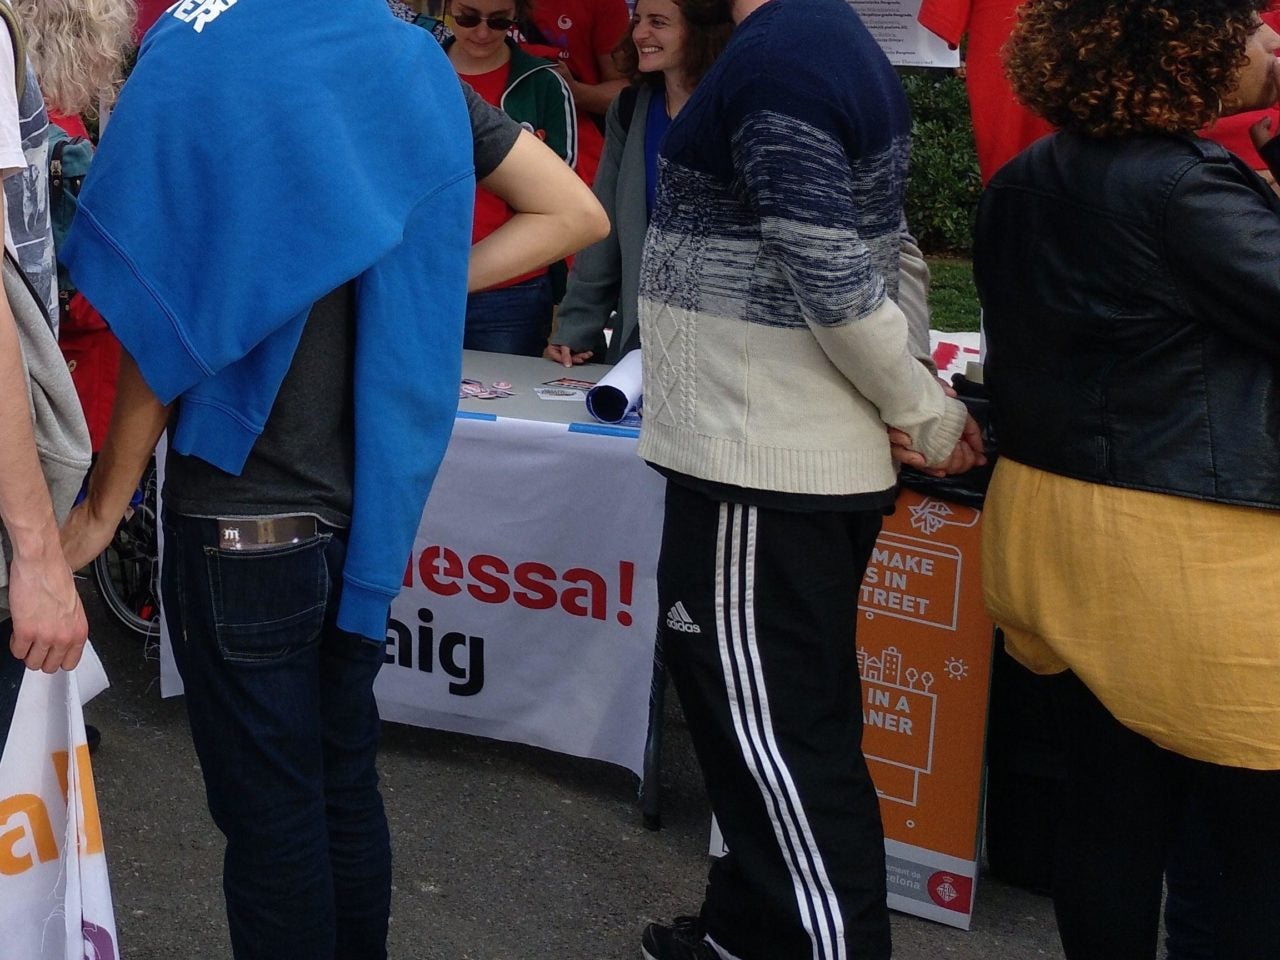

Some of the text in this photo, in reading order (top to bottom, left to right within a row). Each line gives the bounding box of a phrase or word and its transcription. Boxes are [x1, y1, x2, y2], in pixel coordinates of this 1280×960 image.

[871, 547, 934, 577] MAKE
[402, 544, 634, 627] essa!
[884, 570, 907, 591] IN
[666, 618, 701, 633] adidas
[867, 687, 911, 714] IN A
